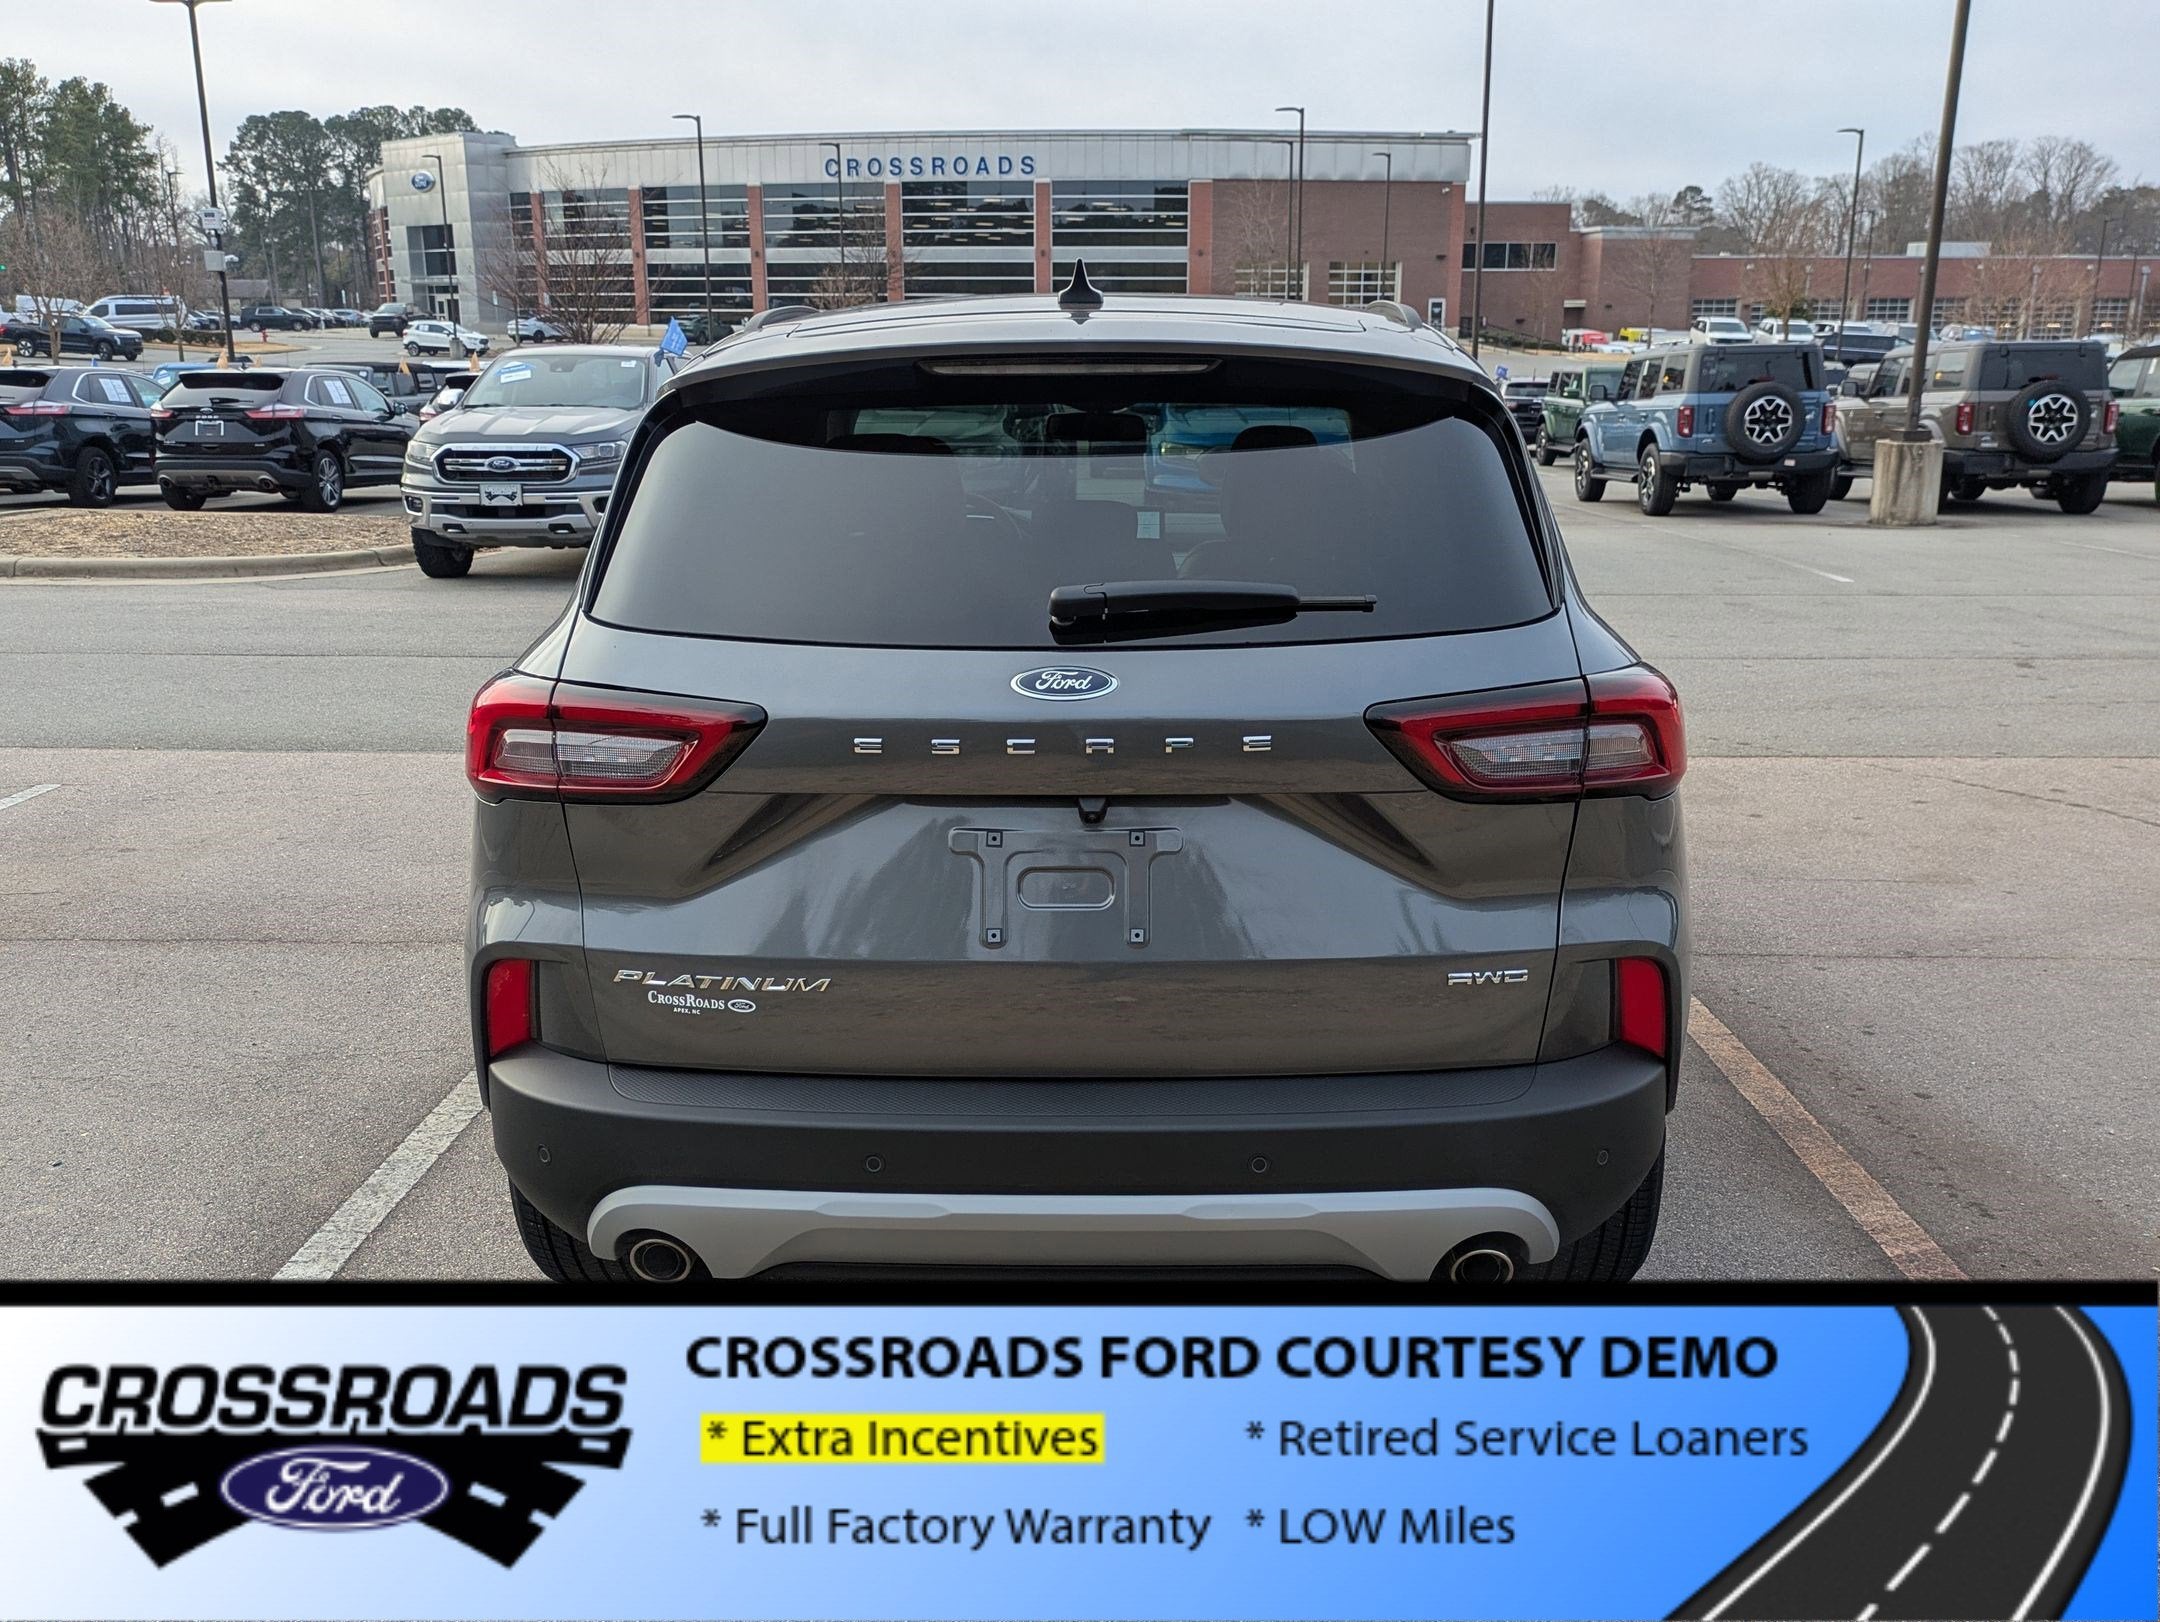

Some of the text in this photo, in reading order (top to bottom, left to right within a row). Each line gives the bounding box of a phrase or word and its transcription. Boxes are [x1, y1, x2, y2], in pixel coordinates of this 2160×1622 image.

[825, 156, 1035, 177] CROSSROADS
[1034, 670, 1092, 692] Ford
[853, 735, 1273, 755] ESCAPE
[612, 969, 832, 992] PLATINUM
[1447, 969, 1528, 986] AWD
